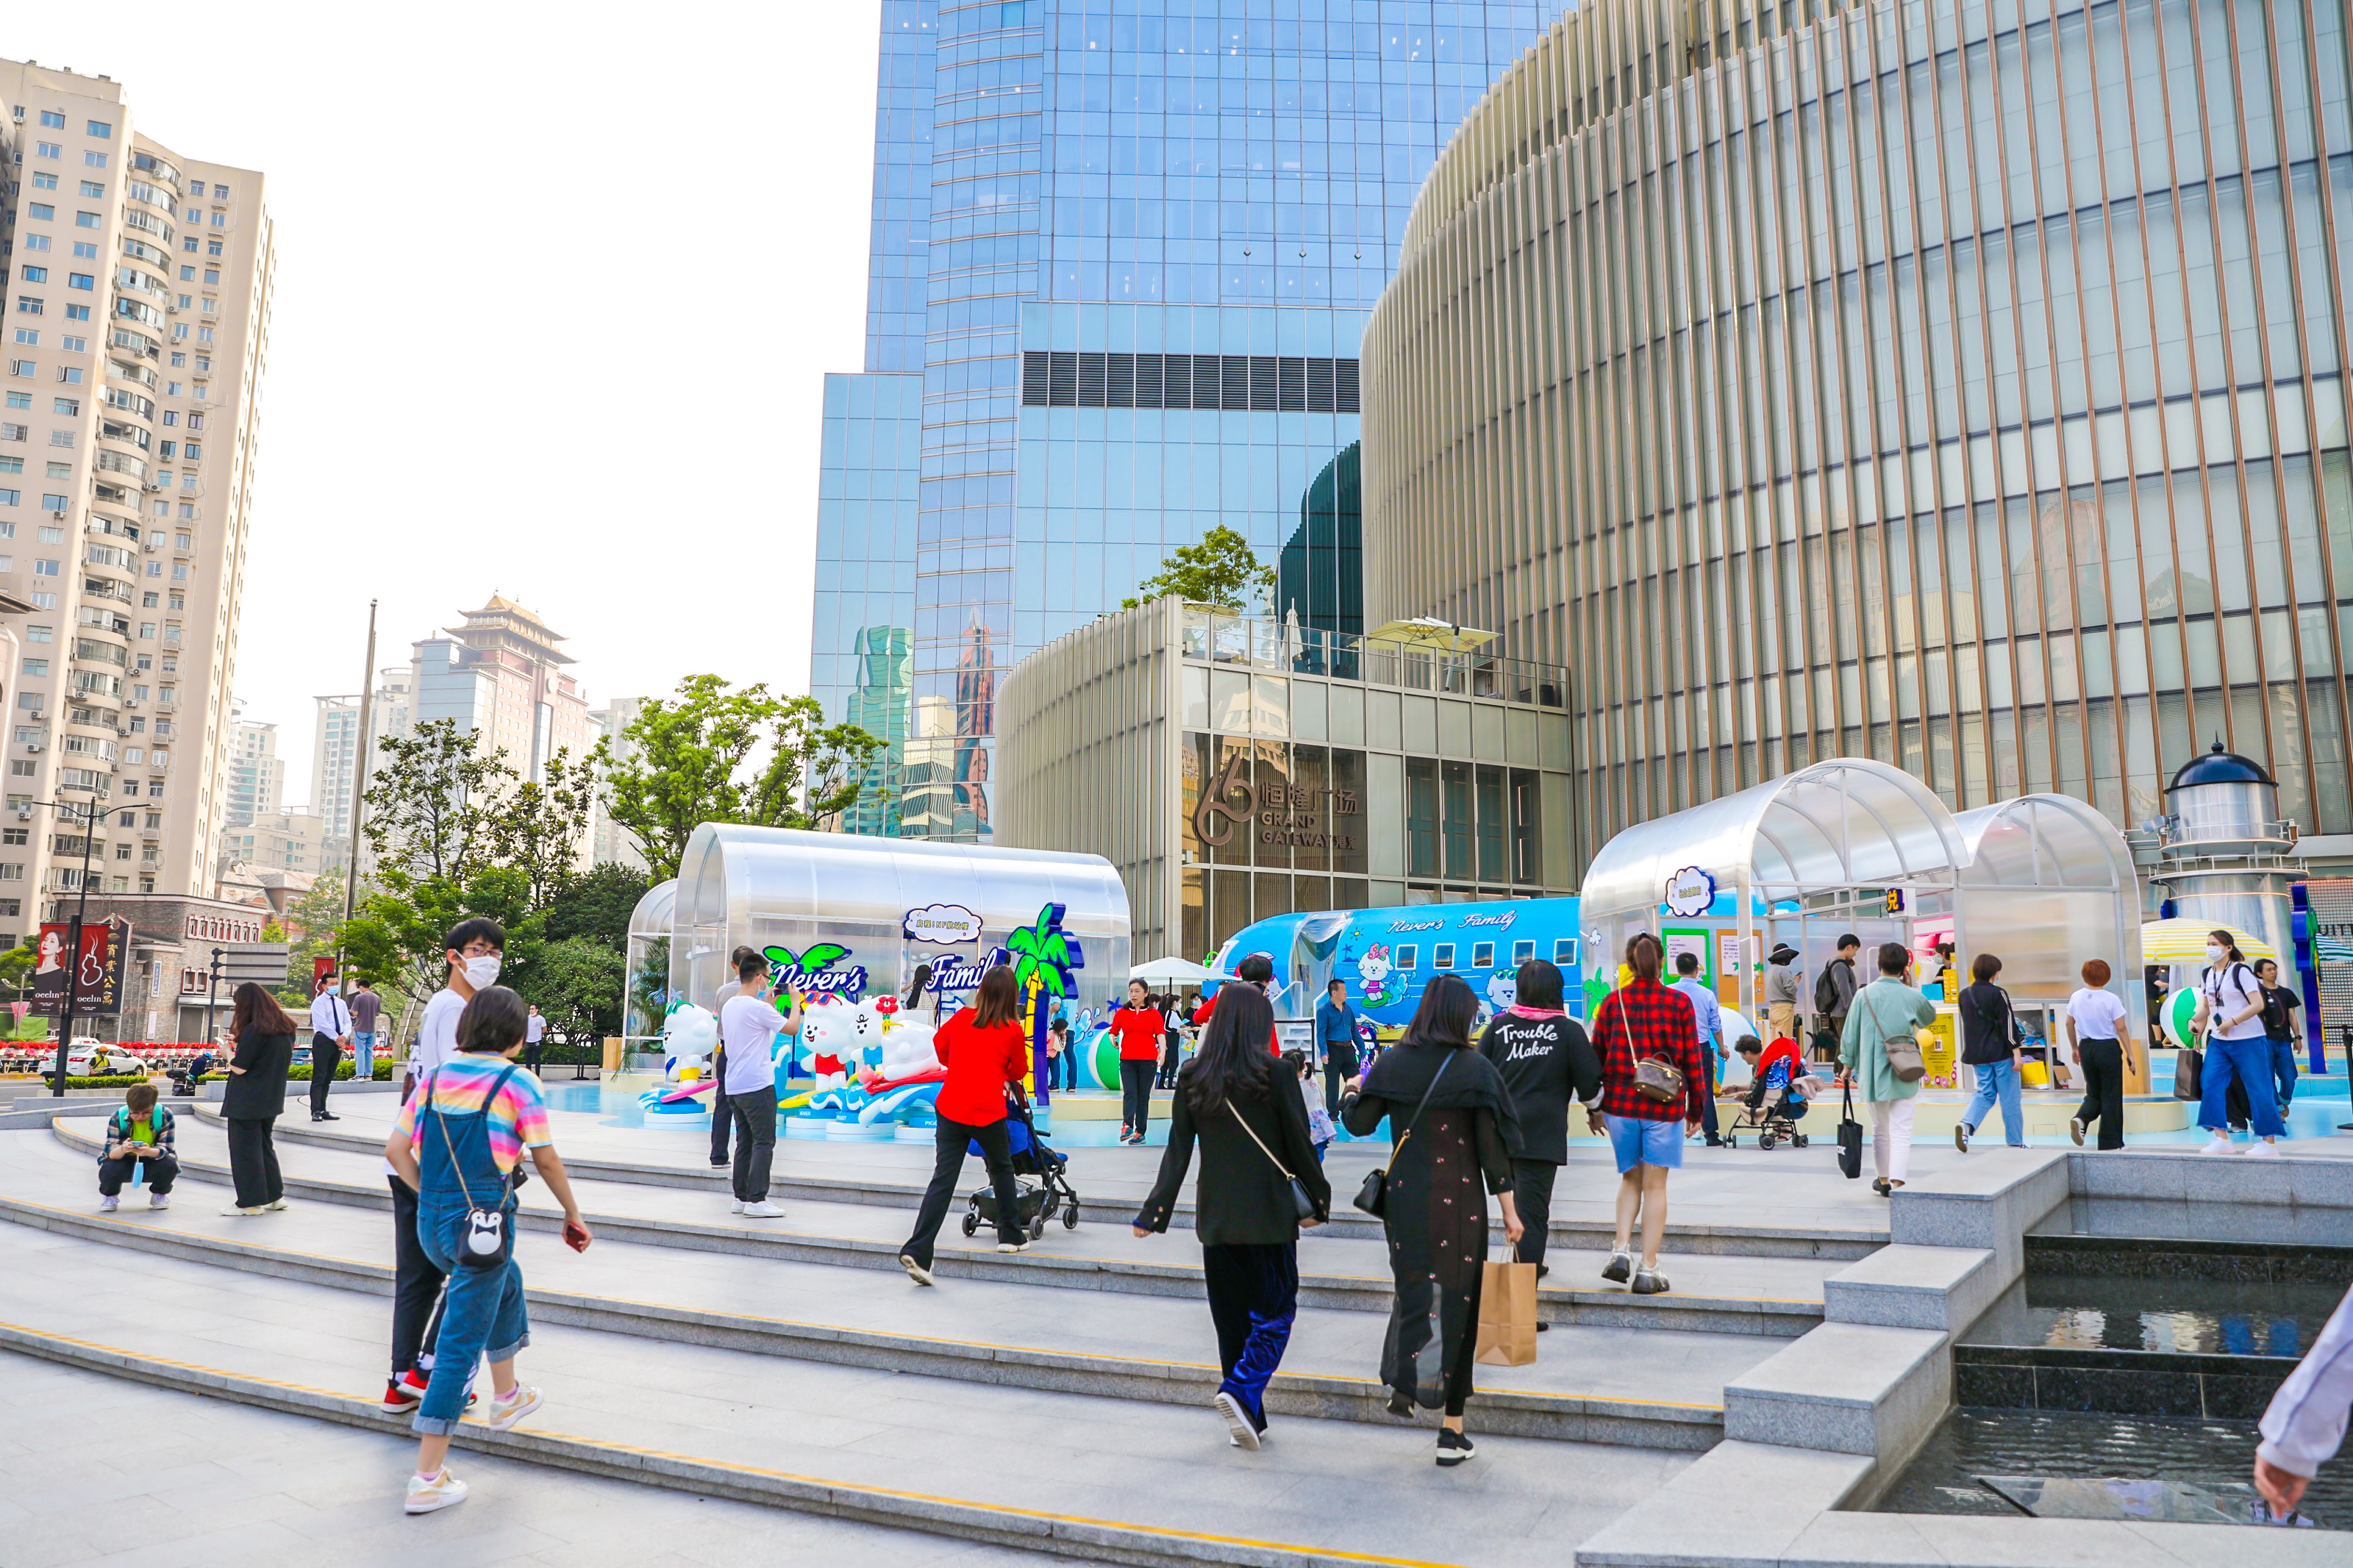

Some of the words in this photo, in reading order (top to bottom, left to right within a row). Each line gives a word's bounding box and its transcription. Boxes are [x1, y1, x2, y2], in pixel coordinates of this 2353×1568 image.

[1261, 781, 1358, 815] 恒隆广场
[1261, 811, 1317, 828] GRAND
[1261, 829, 1332, 848] GATEWAY
[1334, 835, 1357, 850] 港汇
[1887, 889, 1899, 911] 兑
[1386, 919, 1445, 934] Never's
[1458, 910, 1518, 931] Family
[773, 963, 862, 991] Never's
[925, 948, 999, 990] Famil
[1494, 1023, 1559, 1044] Trouble
[1506, 1040, 1553, 1062] Maker
